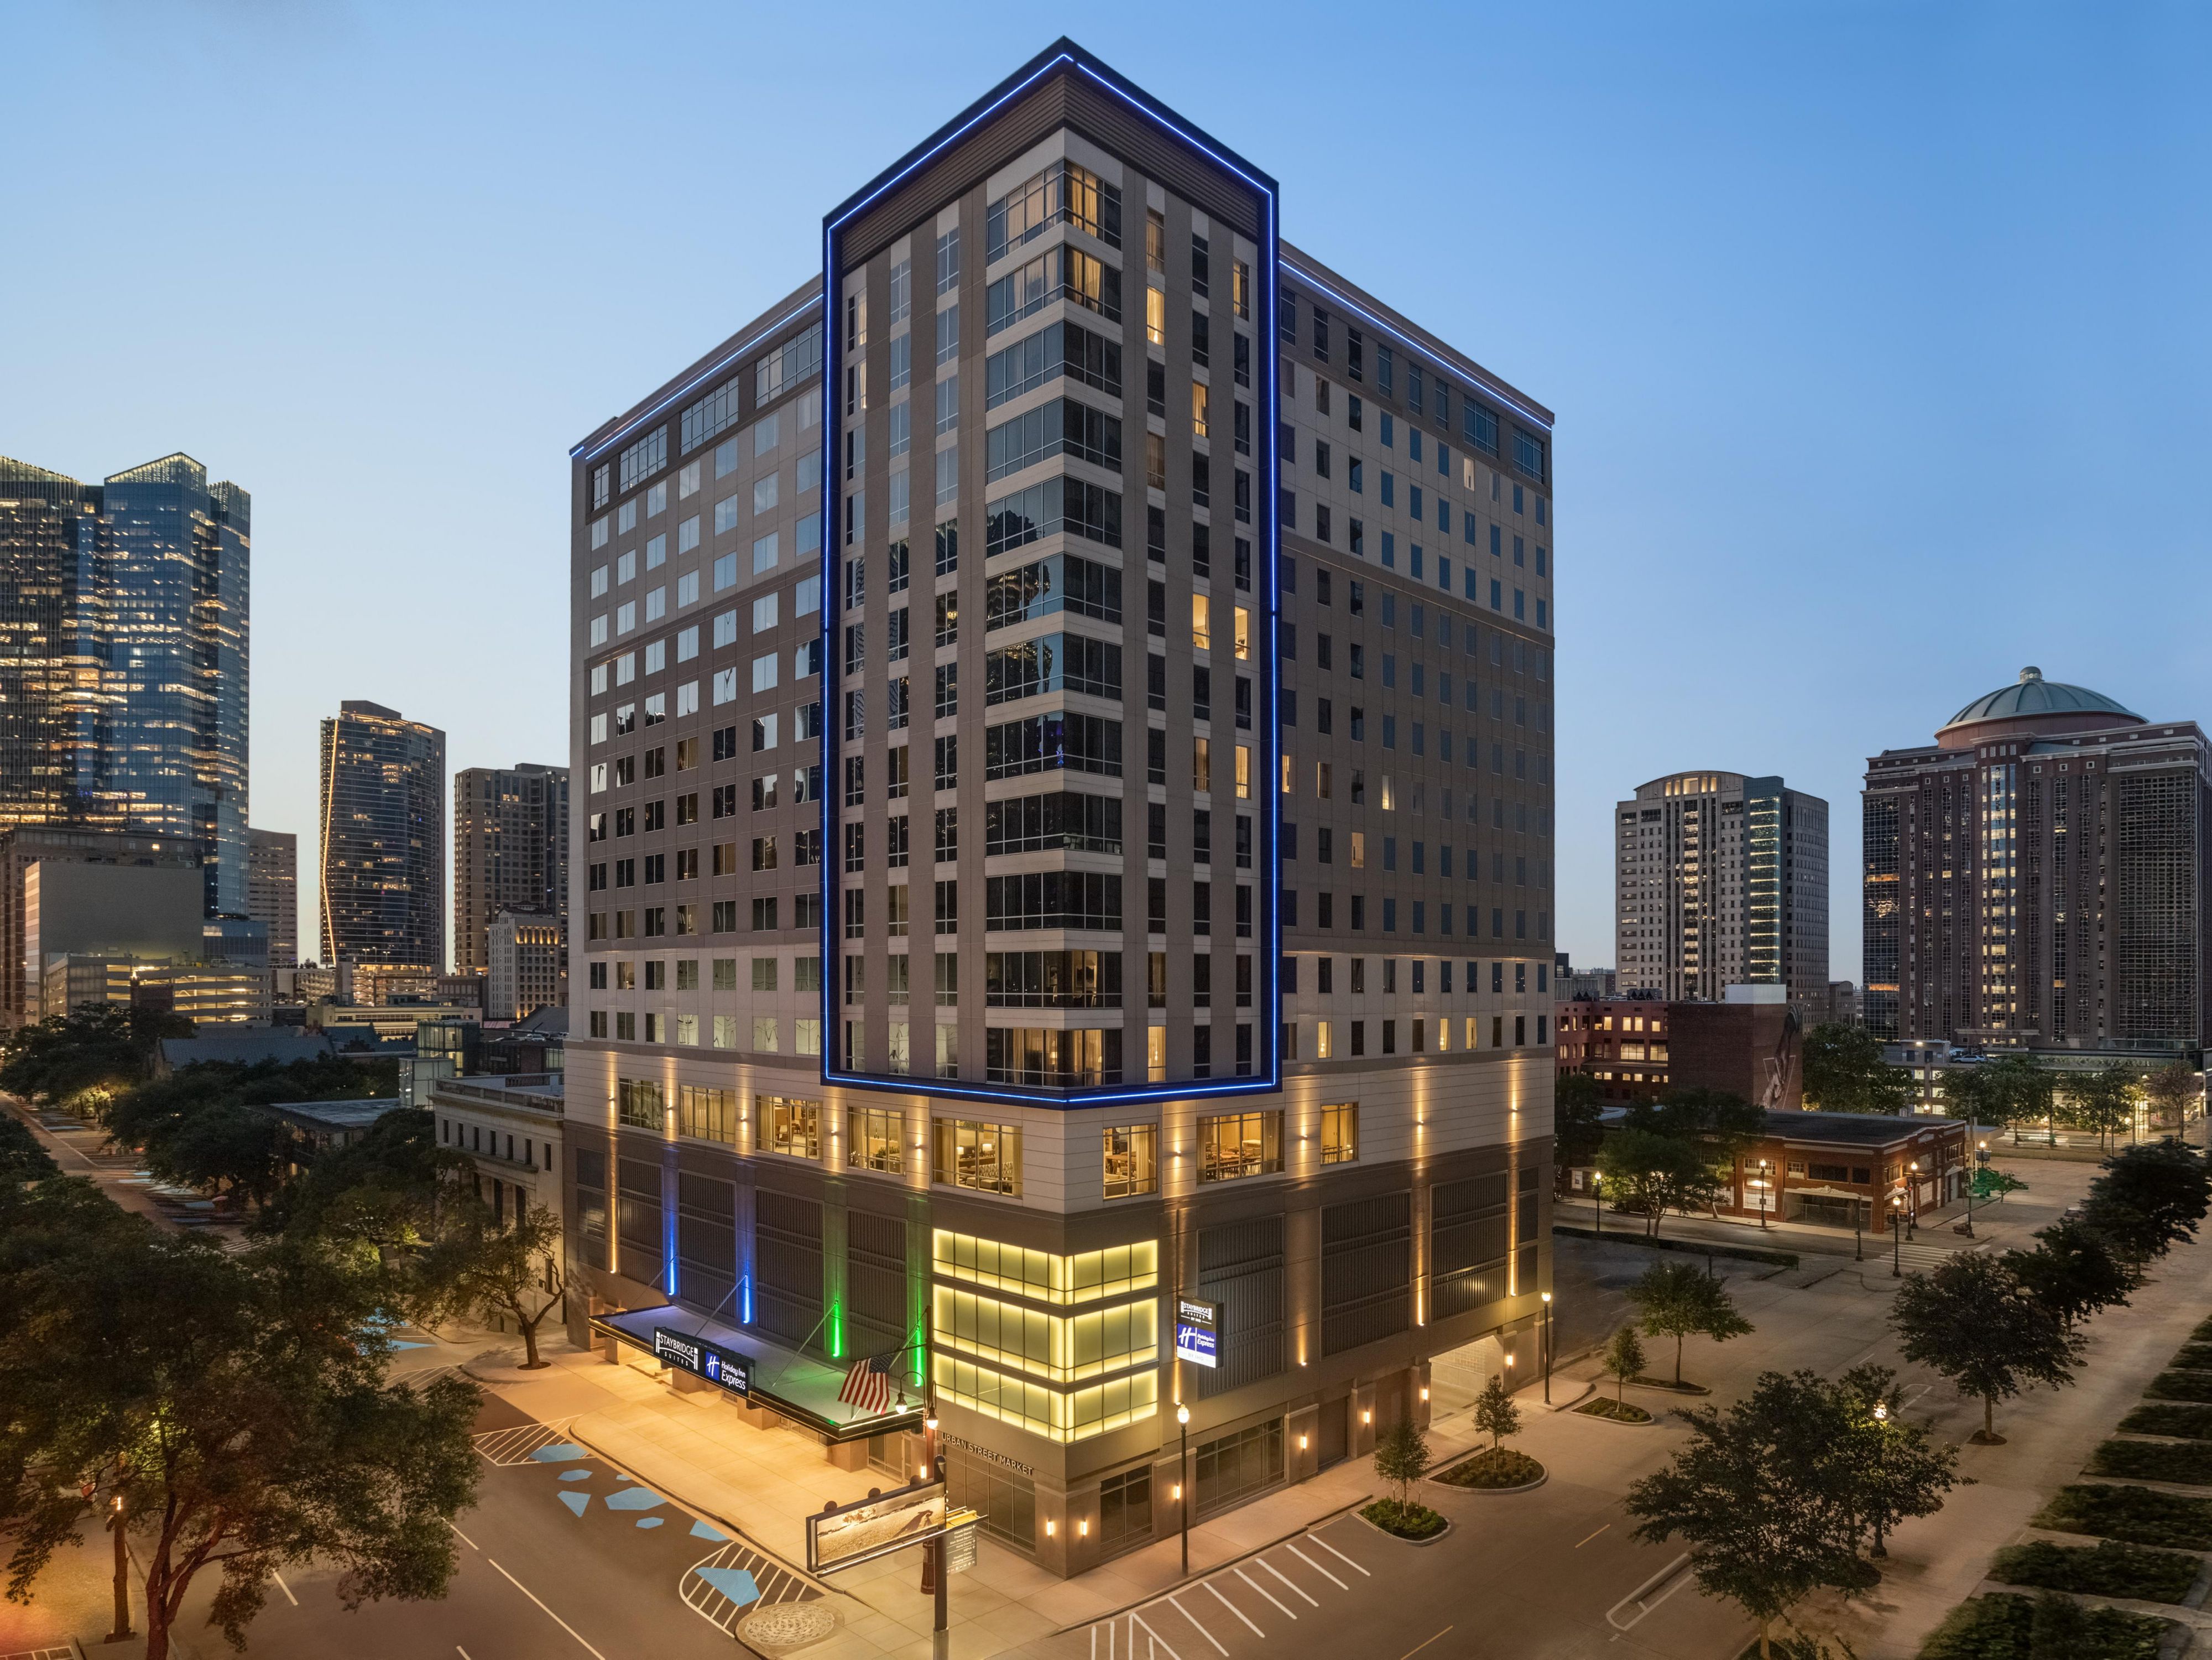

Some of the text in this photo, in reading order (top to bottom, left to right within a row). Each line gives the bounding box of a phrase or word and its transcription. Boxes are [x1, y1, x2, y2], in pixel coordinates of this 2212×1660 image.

[1183, 1303, 1208, 1313] STAYBRIDGE
[660, 1334, 694, 1357] STAYBRIDGE
[1197, 1339, 1214, 1348] Express
[664, 1351, 688, 1366] SUITES
[721, 1360, 738, 1376] Holiday
[721, 1371, 746, 1390] Express
[942, 1433, 1033, 1476] URBAN STREET MARKET
